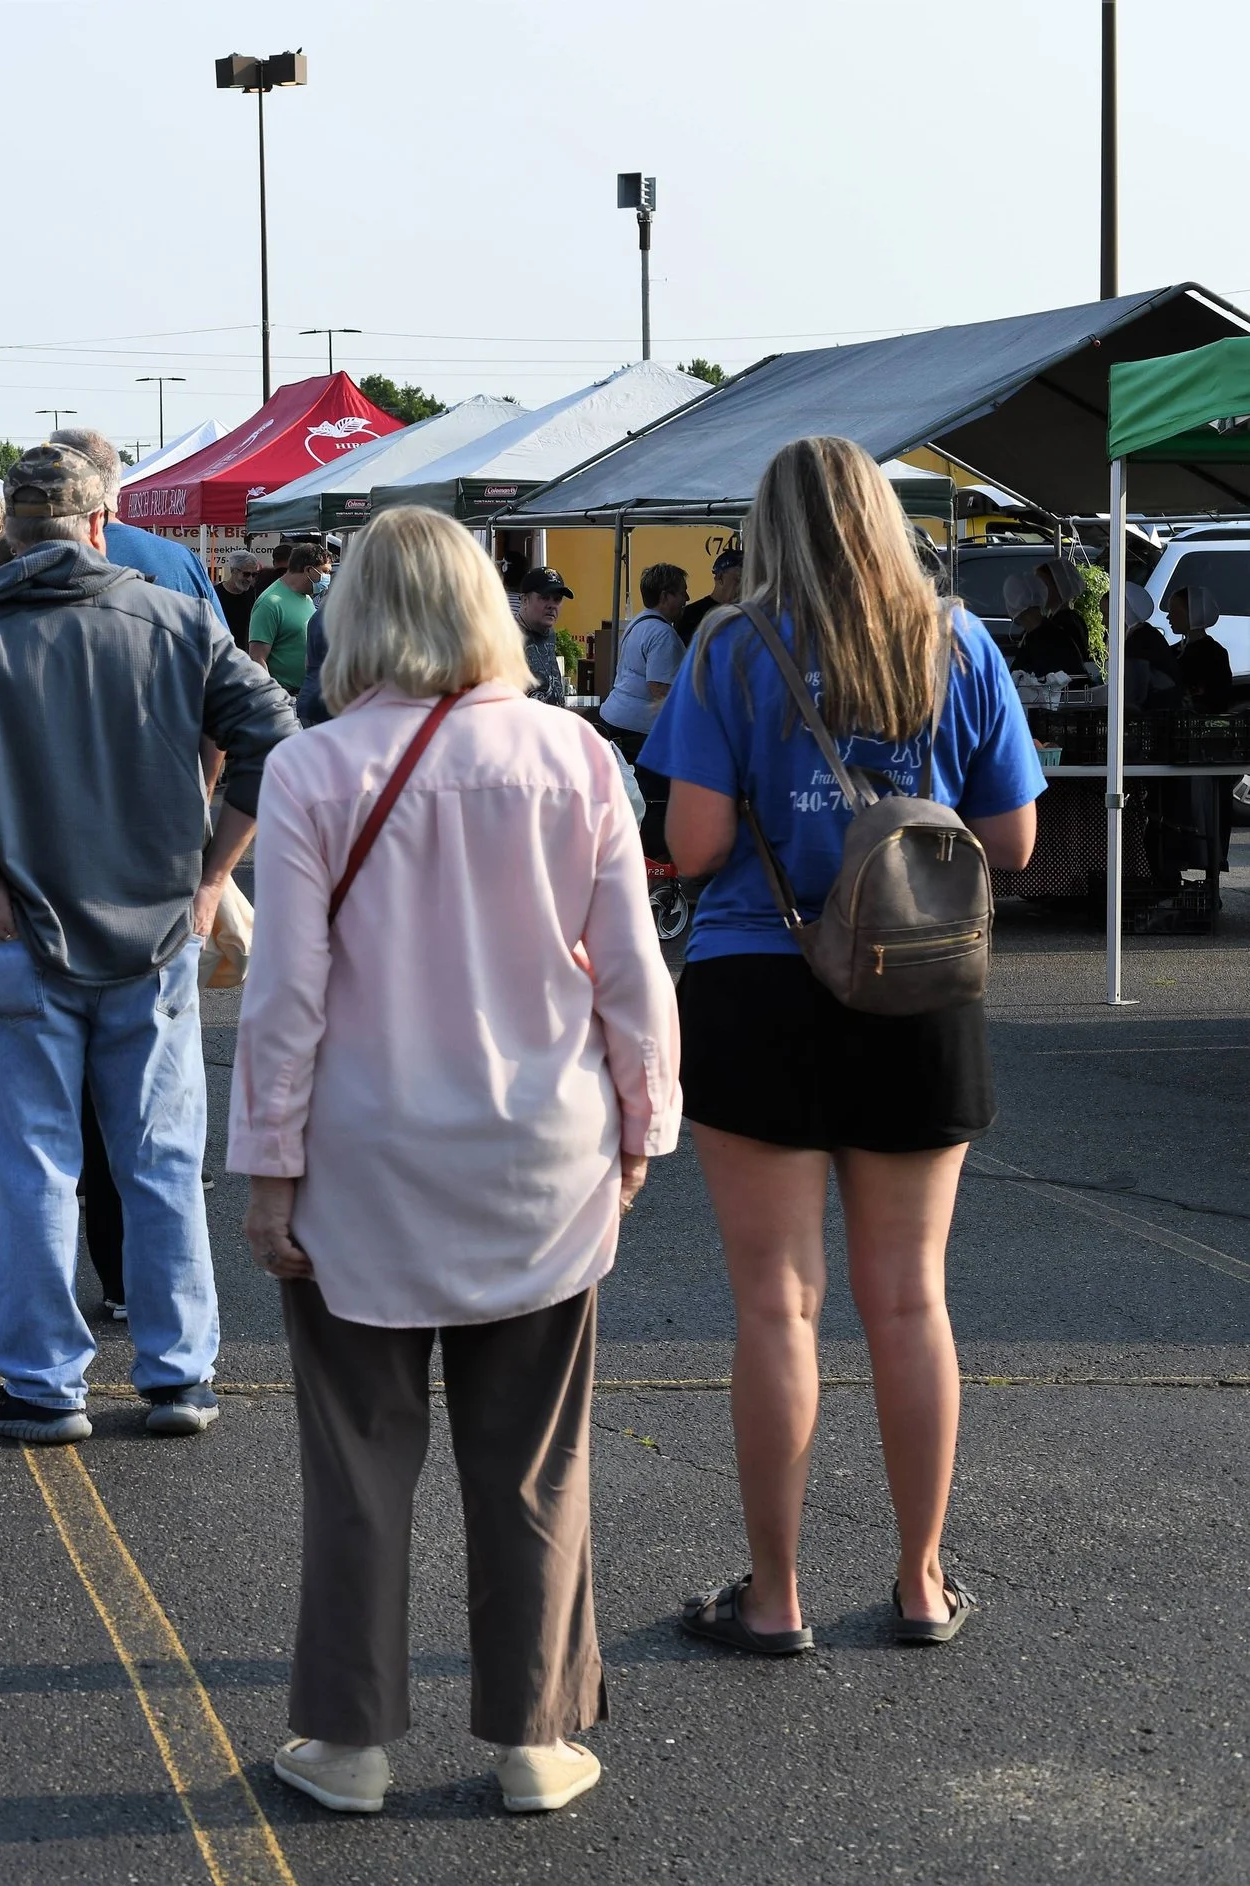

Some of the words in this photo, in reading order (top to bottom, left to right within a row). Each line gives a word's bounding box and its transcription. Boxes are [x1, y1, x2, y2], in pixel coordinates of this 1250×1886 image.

[128, 491, 149, 518] HIRSCH
[150, 490, 169, 516] FRUIT
[169, 489, 187, 515] FARM
